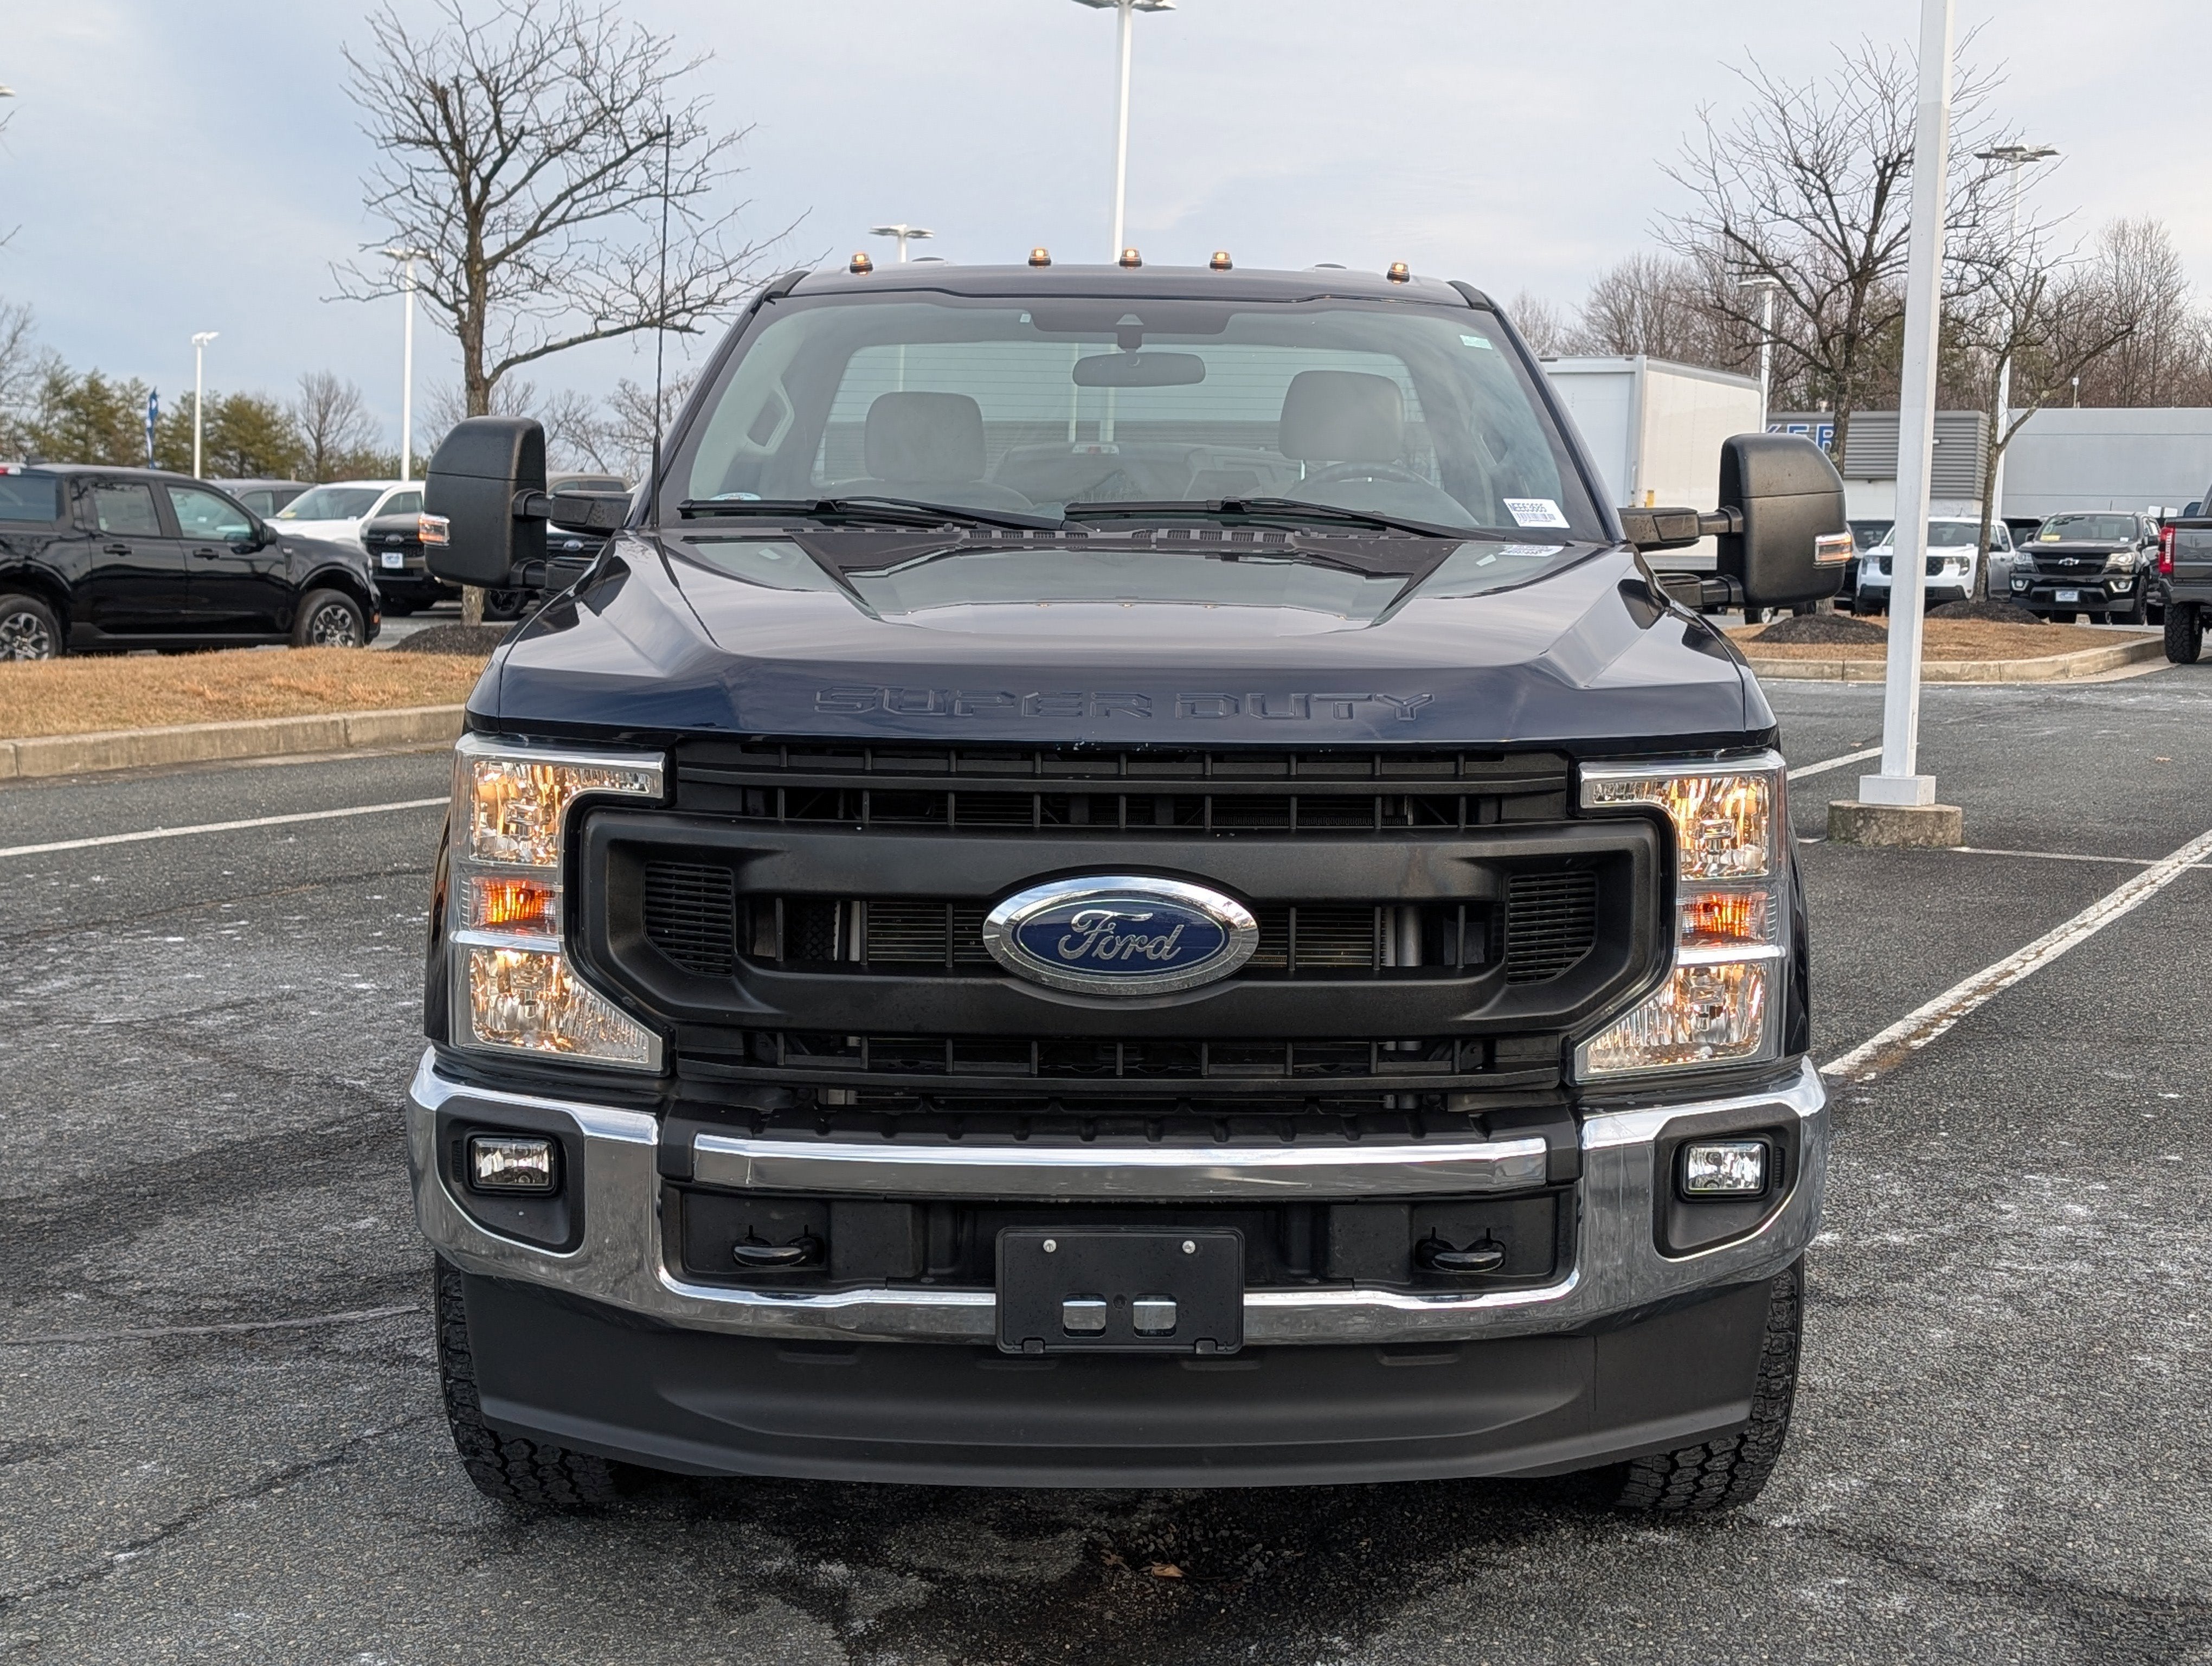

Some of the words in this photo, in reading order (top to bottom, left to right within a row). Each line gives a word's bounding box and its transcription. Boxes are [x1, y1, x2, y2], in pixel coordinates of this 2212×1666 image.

[814, 685, 1153, 719] SUPER
[1174, 692, 1436, 722] DUTY
[1058, 909, 1185, 960] Ford
